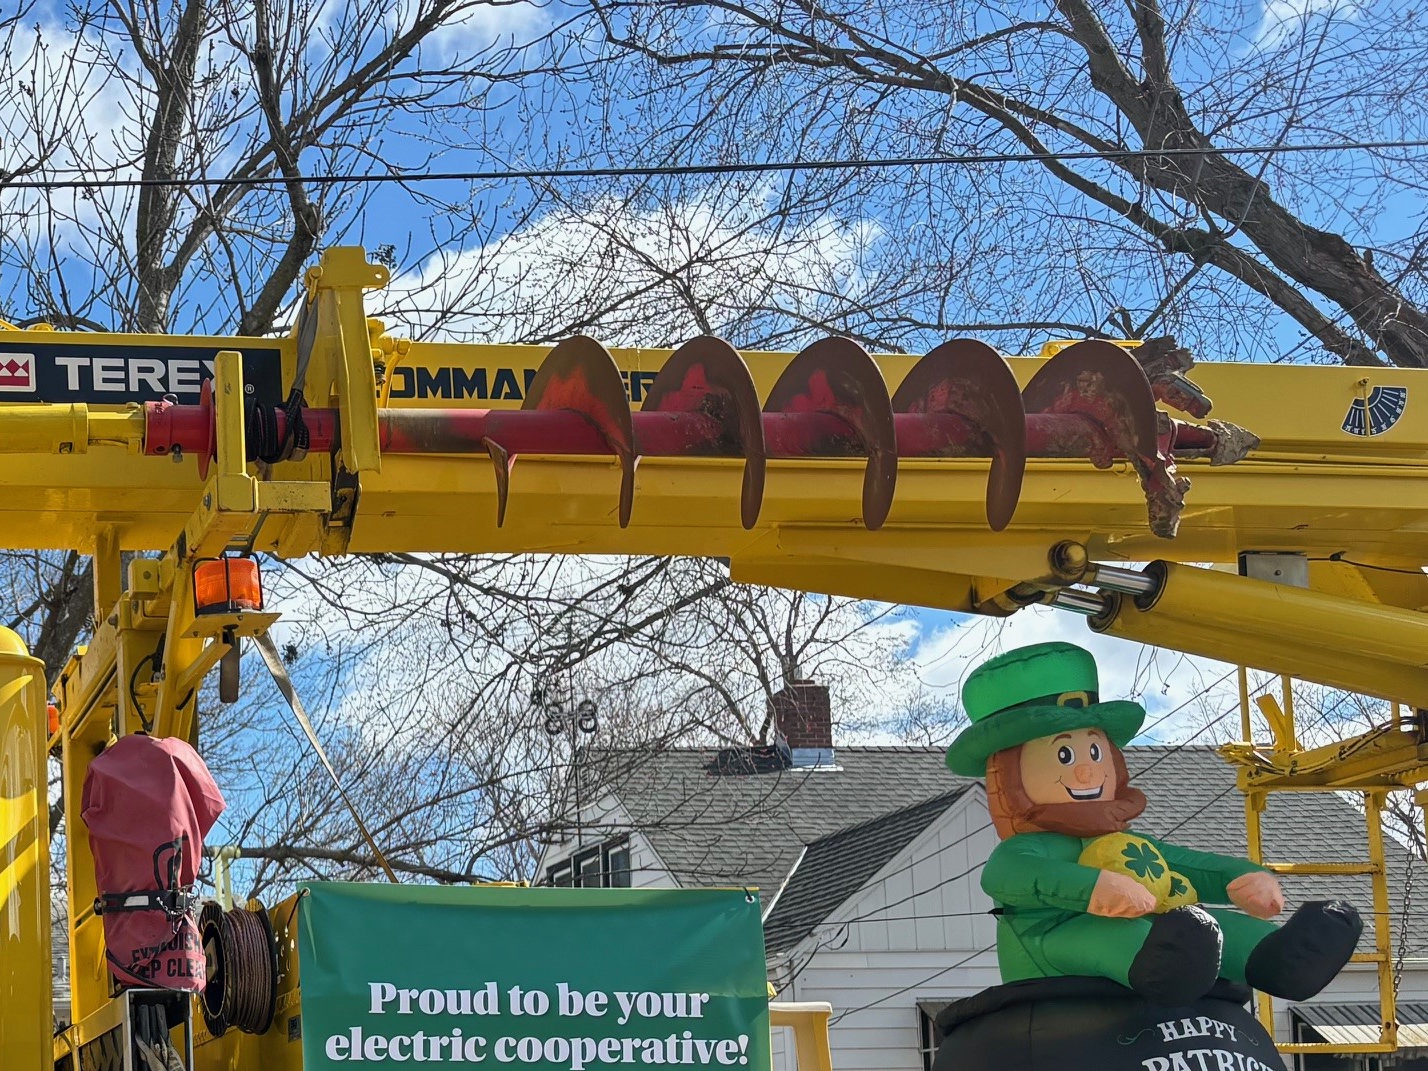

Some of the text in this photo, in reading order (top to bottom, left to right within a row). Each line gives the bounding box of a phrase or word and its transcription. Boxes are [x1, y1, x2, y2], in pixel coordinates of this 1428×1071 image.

[167, 958, 205, 979] CLEA
[368, 982, 710, 1025] Proud to be your
[1156, 1016, 1238, 1042] HAPPY
[324, 1026, 749, 1071] electric cooperative!
